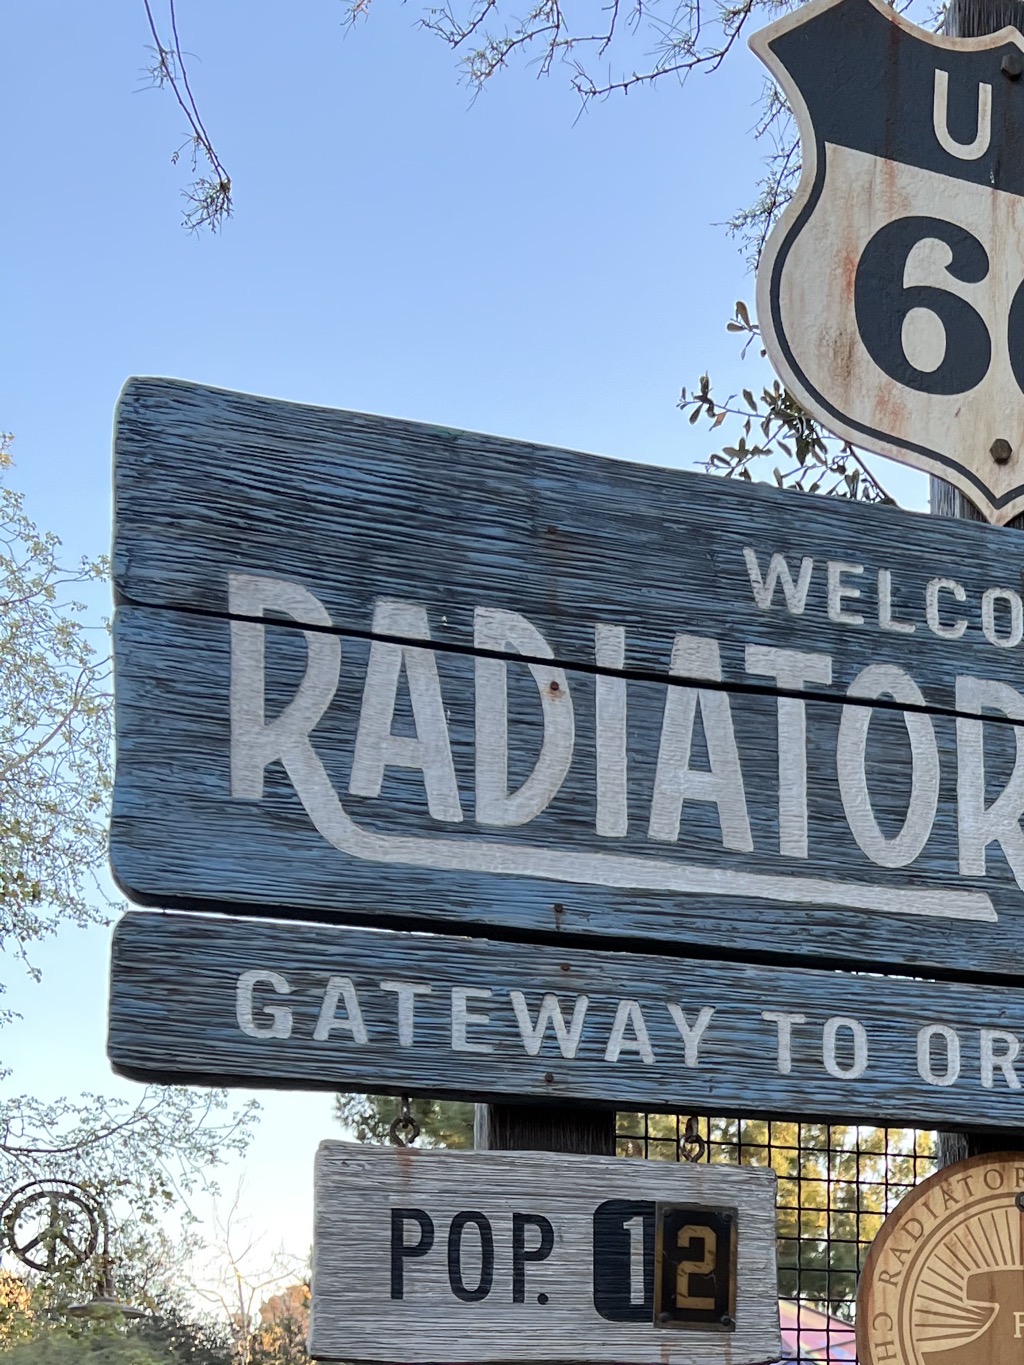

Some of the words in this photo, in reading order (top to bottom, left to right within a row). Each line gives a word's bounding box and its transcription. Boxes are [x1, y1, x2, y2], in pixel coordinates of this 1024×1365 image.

[235, 969, 716, 1069] GATEWAY
[761, 1010, 869, 1080] TO
[390, 1207, 555, 1304] POP.
[622, 1214, 718, 1311] 12
